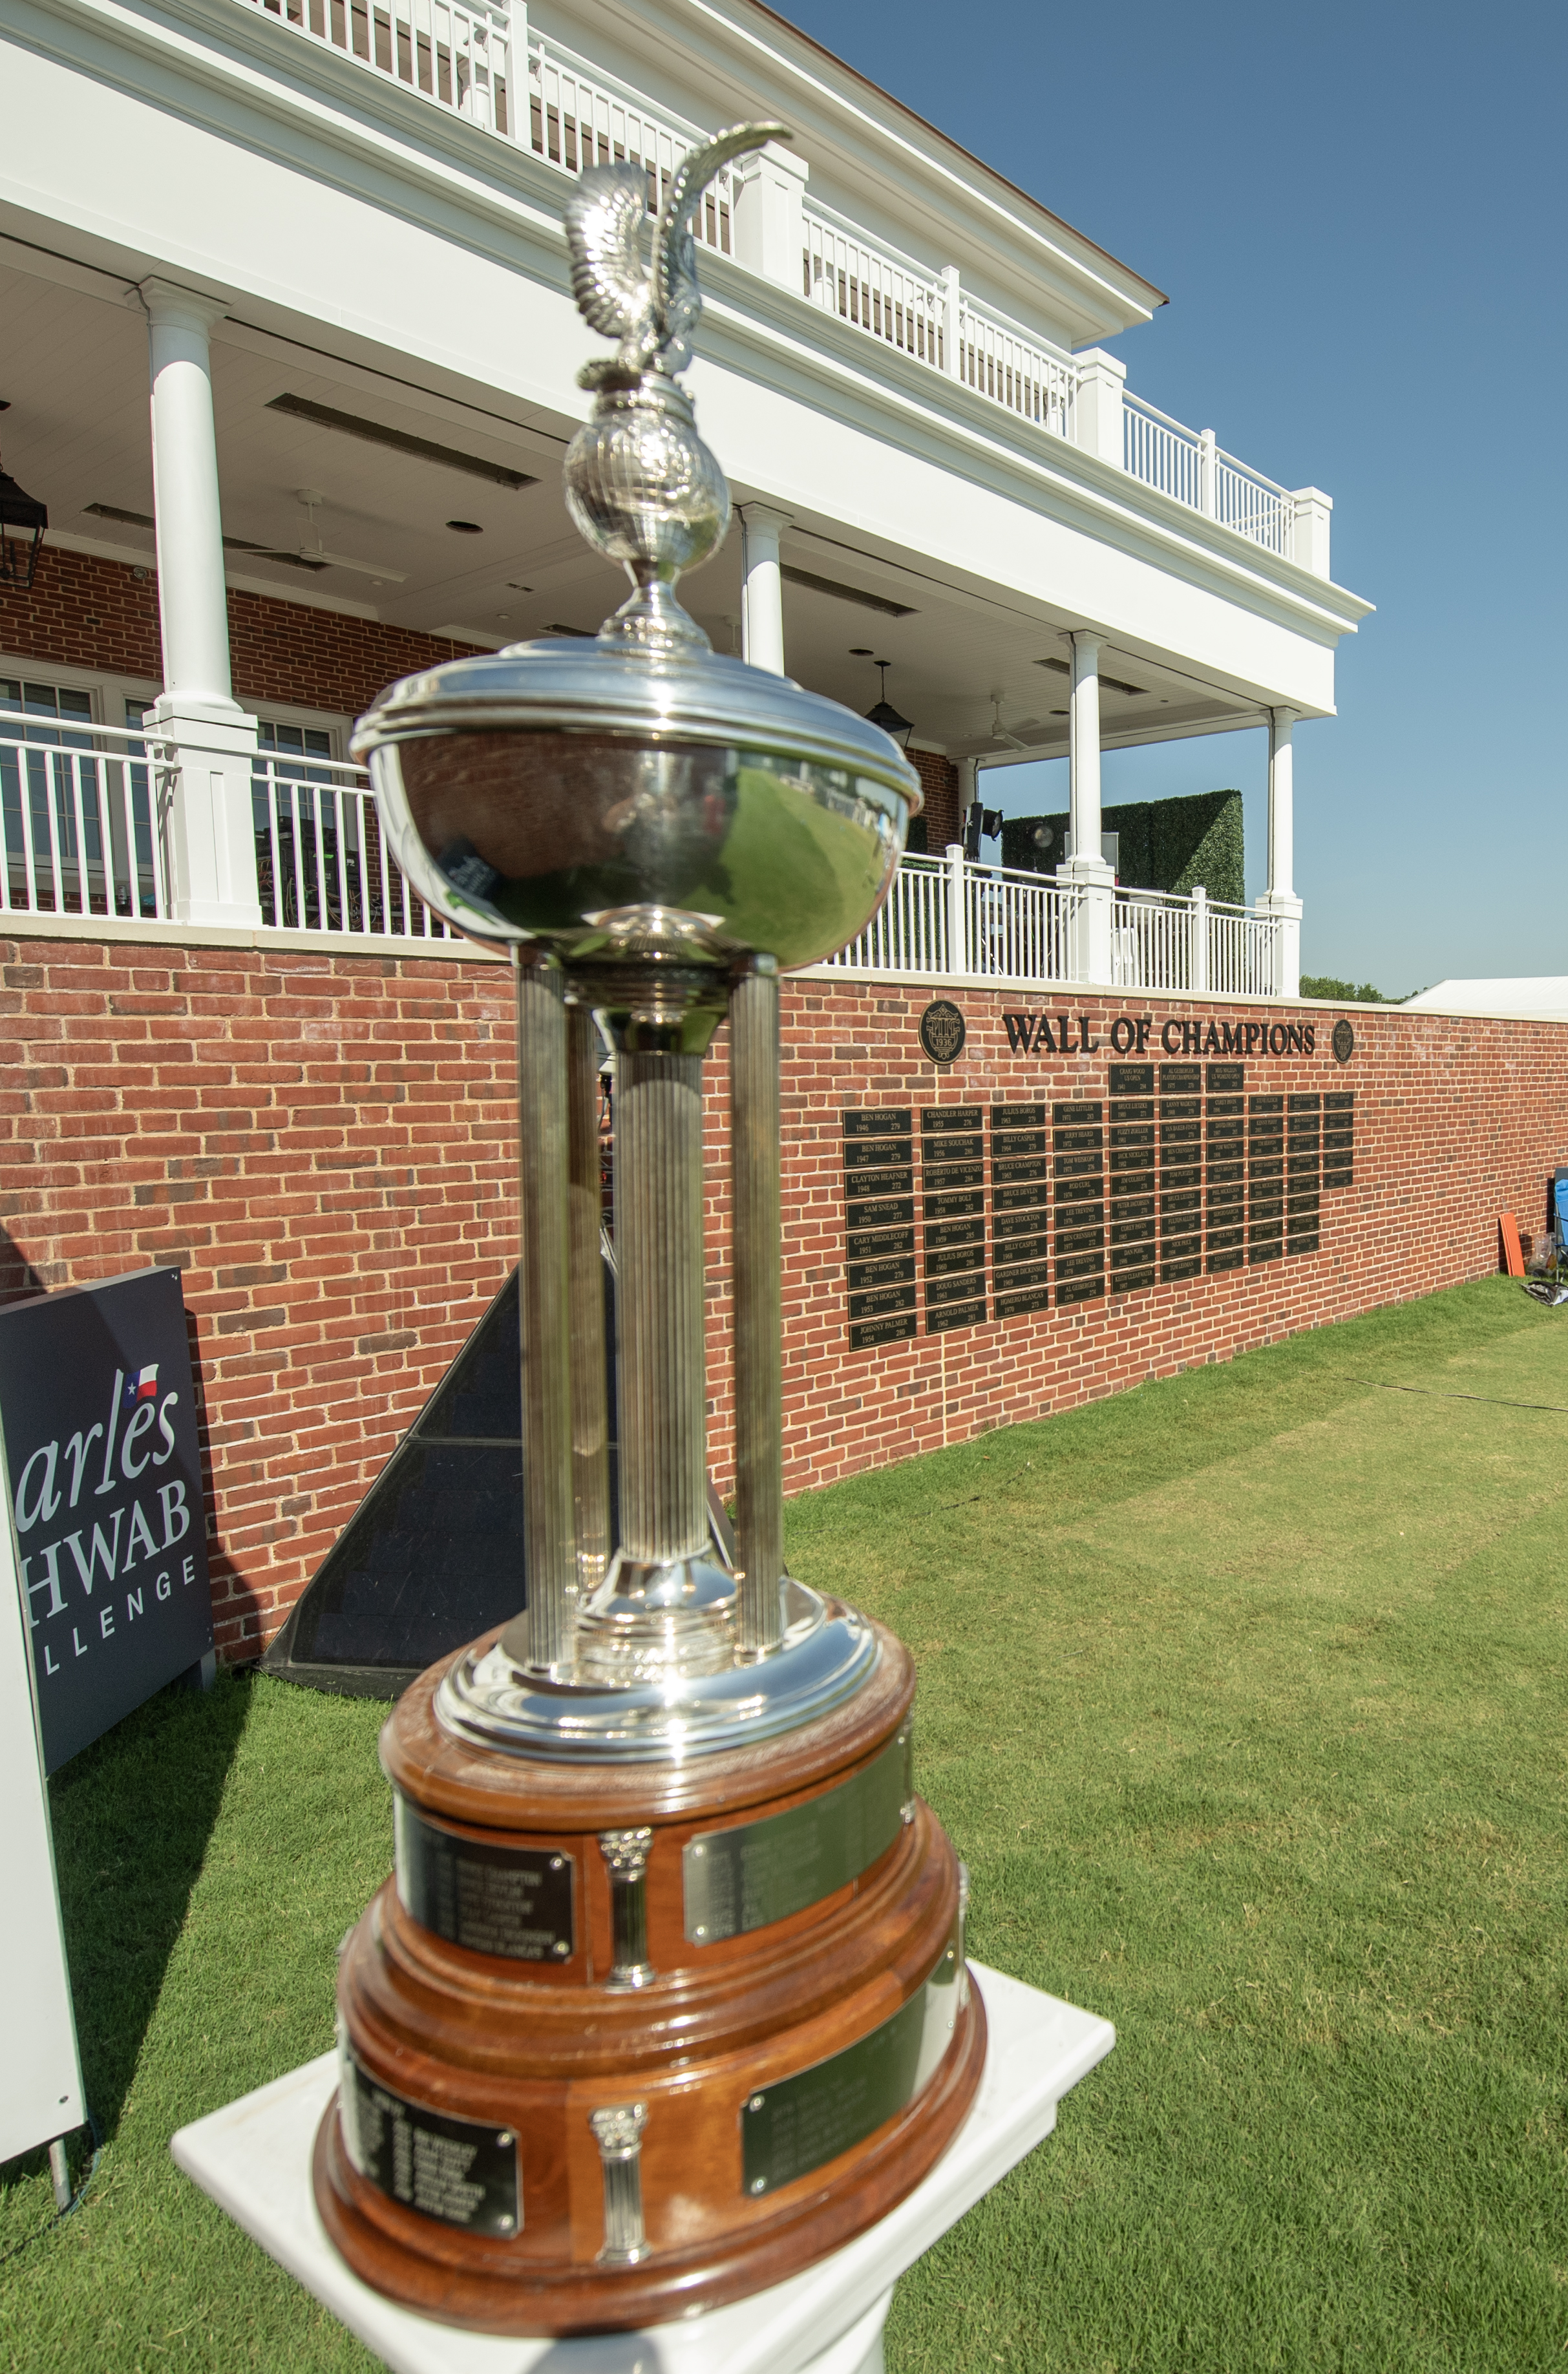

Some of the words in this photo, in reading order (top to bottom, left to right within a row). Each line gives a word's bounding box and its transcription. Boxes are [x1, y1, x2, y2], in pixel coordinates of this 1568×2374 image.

[1002, 1013, 1099, 1054] WALL
[1110, 1017, 1151, 1054] OF
[1161, 1019, 1315, 1055] CHAMPIONS
[852, 1174, 880, 1183] CLAYTON
[881, 1172, 907, 1180] HEAFNER
[1015, 1214, 1040, 1223] STOCKTON
[854, 1236, 871, 1245] CARY
[871, 1231, 908, 1242] MIDDLECOFF
[1074, 1231, 1097, 1240] CRENSHAW
[938, 1253, 955, 1261] JULIUS
[957, 1250, 974, 1258] BOROS
[1075, 1256, 1094, 1265] TREVINO
[879, 1262, 900, 1271] HOGAN
[996, 1269, 1019, 1278] GARDNER
[1020, 1266, 1045, 1275] DICKINSON
[937, 1282, 951, 1290] DOUG
[953, 1277, 976, 1288] SANDERS
[1072, 1281, 1096, 1291] GEIBERGER
[866, 1295, 878, 1303] BEN
[880, 1291, 900, 1300] HOGAN
[1001, 1295, 1021, 1305] HOMERO
[1022, 1292, 1043, 1301] BLANCAS
[861, 1306, 873, 1314] 1953
[935, 1309, 957, 1319] ARNOLD
[958, 1304, 979, 1313] PALMER
[860, 1324, 884, 1334] JOHNNY
[885, 1319, 907, 1329] PALMER
[862, 1335, 874, 1344] 1954
[16, 1368, 178, 1532] arles
[21, 1479, 190, 1629] HWAB
[45, 1554, 195, 1675] LLENGE
